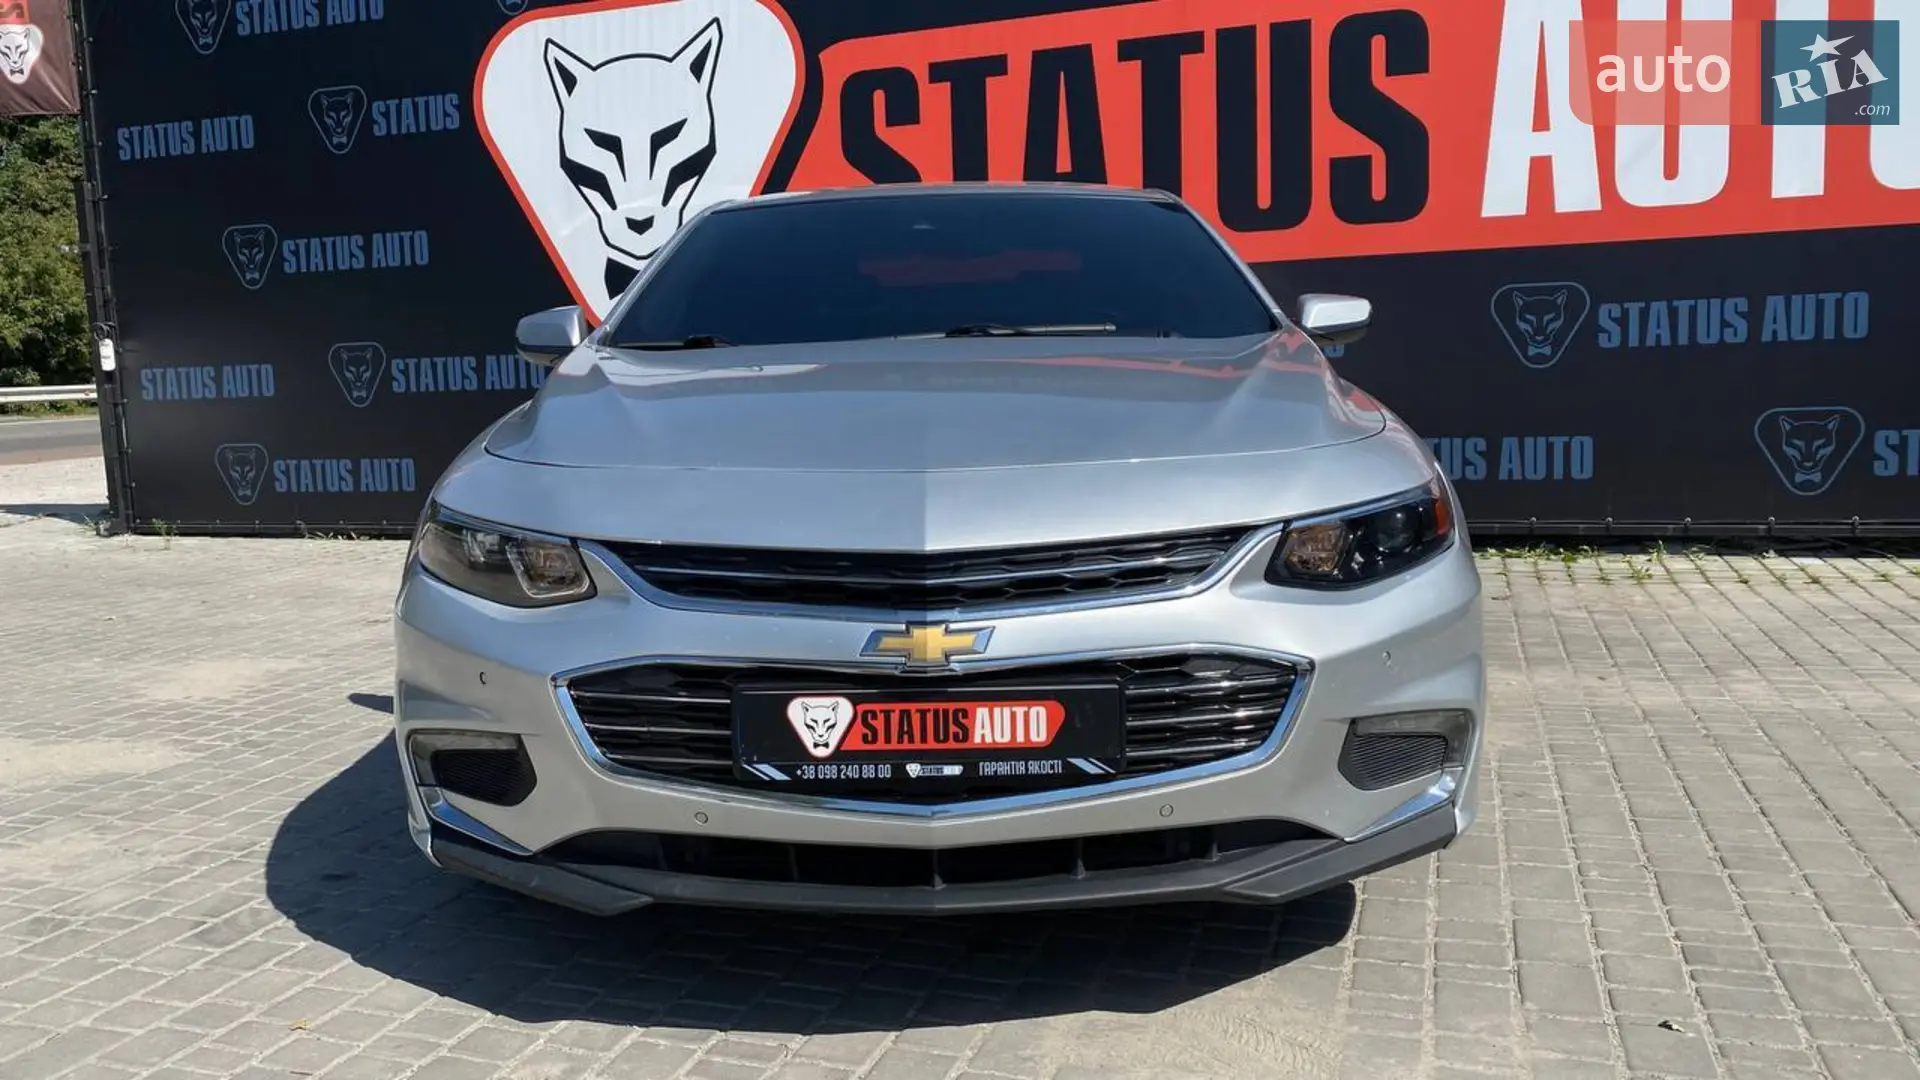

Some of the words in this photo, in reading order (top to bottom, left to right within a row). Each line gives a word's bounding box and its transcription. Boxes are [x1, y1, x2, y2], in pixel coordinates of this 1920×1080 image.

[235, 0, 320, 36] STATUS
[326, 0, 384, 27] AUTO
[372, 93, 460, 136] STATUS
[840, 8, 1430, 233] STATUS
[117, 120, 196, 161] STATUS
[201, 114, 255, 154] AUTO
[282, 234, 366, 274] STATUS
[371, 230, 430, 269] AUTO
[1597, 297, 1749, 349] STATUS
[1761, 291, 1870, 343] AUTO
[140, 365, 217, 400] STATUS
[222, 363, 275, 398] AUTO
[391, 356, 478, 393] STATUS
[273, 458, 354, 493] STATUS
[360, 457, 416, 493] AUTO
[1498, 436, 1595, 481] AUTO
[860, 707, 970, 745] STATUS
[973, 705, 1047, 744] AUTO
[796, 764, 816, 779] +38
[817, 764, 838, 779] 098
[840, 764, 860, 779] 240
[861, 764, 876, 779] 88
[877, 763, 892, 778] 00
[978, 761, 1026, 777] ГАРАНТІЯ
[1027, 759, 1063, 775] ЯКОСТІ
